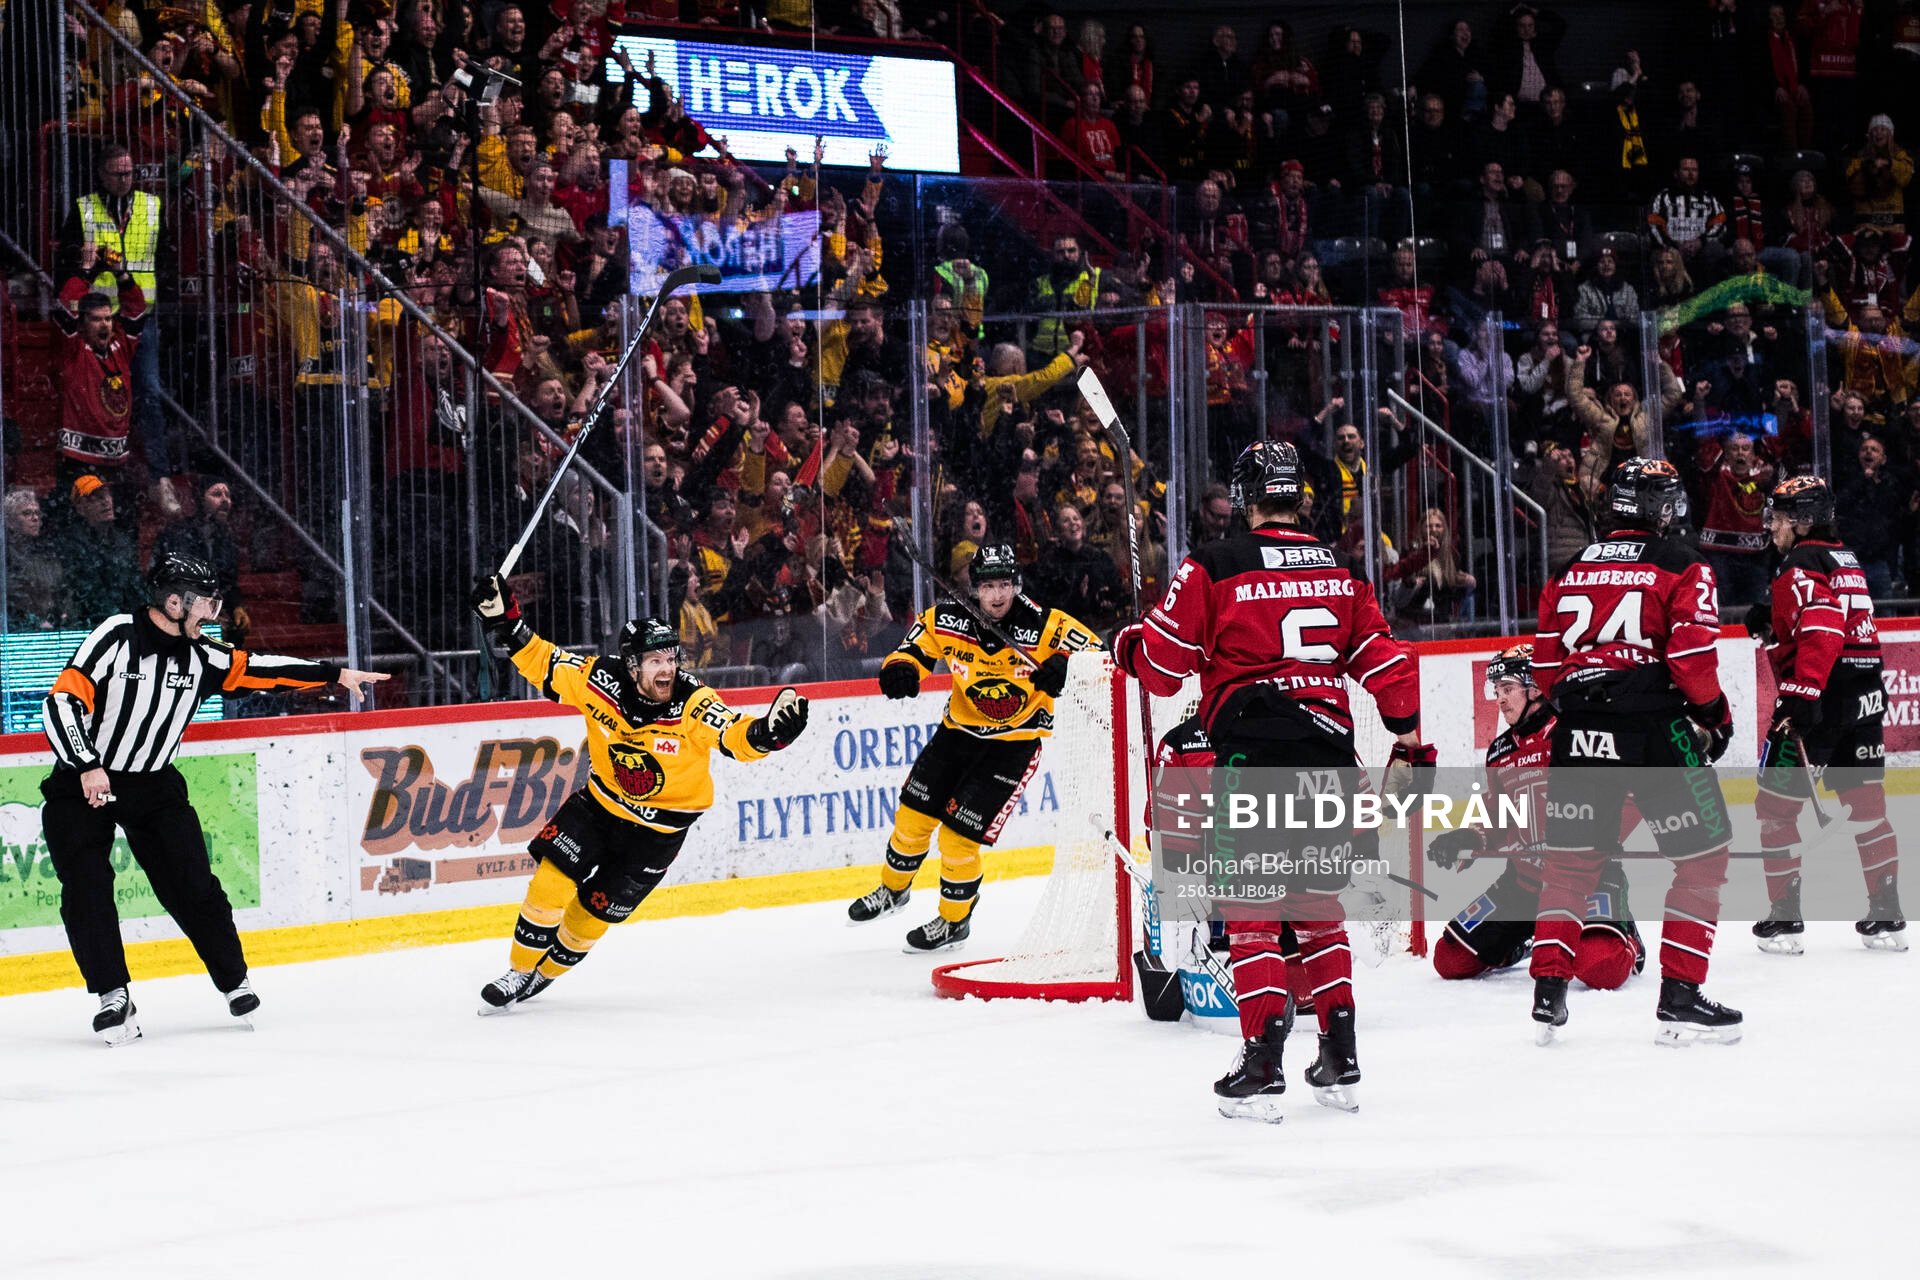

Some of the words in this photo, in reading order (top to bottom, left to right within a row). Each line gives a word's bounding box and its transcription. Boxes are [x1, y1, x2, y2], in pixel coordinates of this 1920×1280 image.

[688, 55, 859, 122] HEROK
[1284, 548, 1333, 563] BRL
[1602, 542, 1639, 556] BRL
[1163, 580, 1182, 611] 6
[1236, 579, 1354, 602] MALMBERG
[1791, 579, 1815, 607] 17
[1556, 591, 1654, 655] 24
[952, 648, 975, 663] LKAB
[168, 675, 193, 687] SHL
[1857, 690, 1884, 719] NA
[656, 740, 676, 754] MAX
[1569, 730, 1621, 760] NA
[1517, 752, 1542, 767] EXACT
[1296, 770, 1344, 800] NA
[955, 812, 983, 831] Energi
[552, 837, 580, 863] Energi
